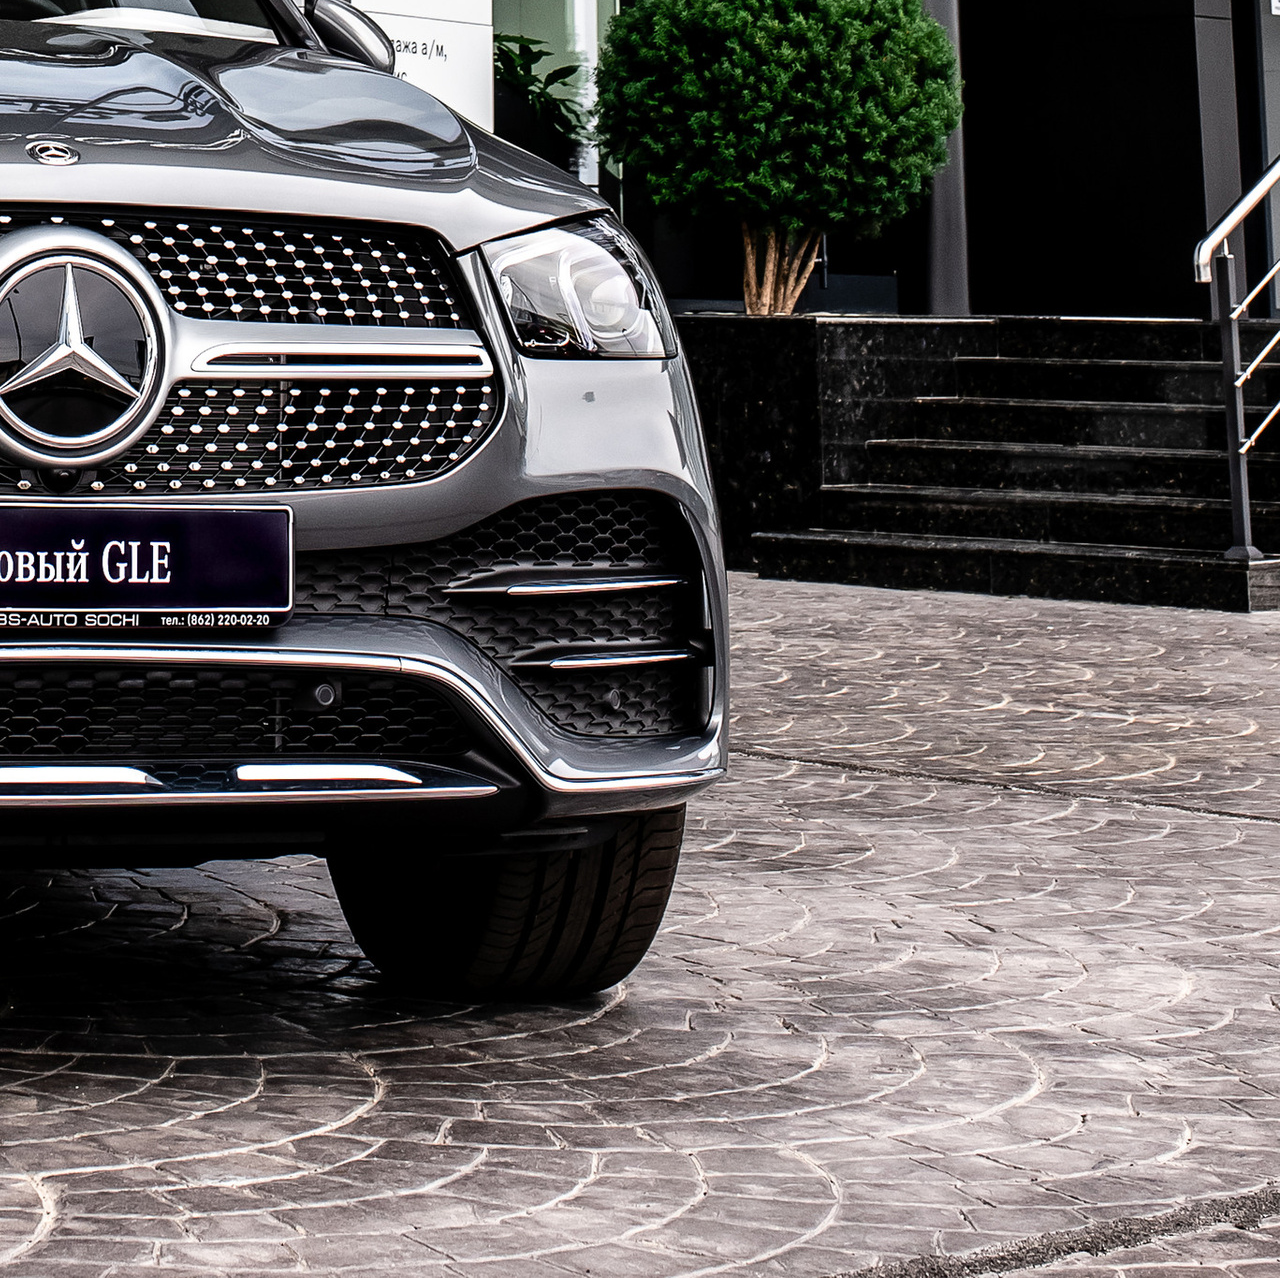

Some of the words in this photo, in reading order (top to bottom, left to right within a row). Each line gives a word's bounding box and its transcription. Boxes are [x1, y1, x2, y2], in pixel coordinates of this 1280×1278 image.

[101, 539, 171, 584] GLE
[84, 613, 140, 628] SOCHI
[160, 615, 185, 627] тел.:
[187, 613, 215, 628] (862)
[217, 613, 271, 627] 220-02-20
